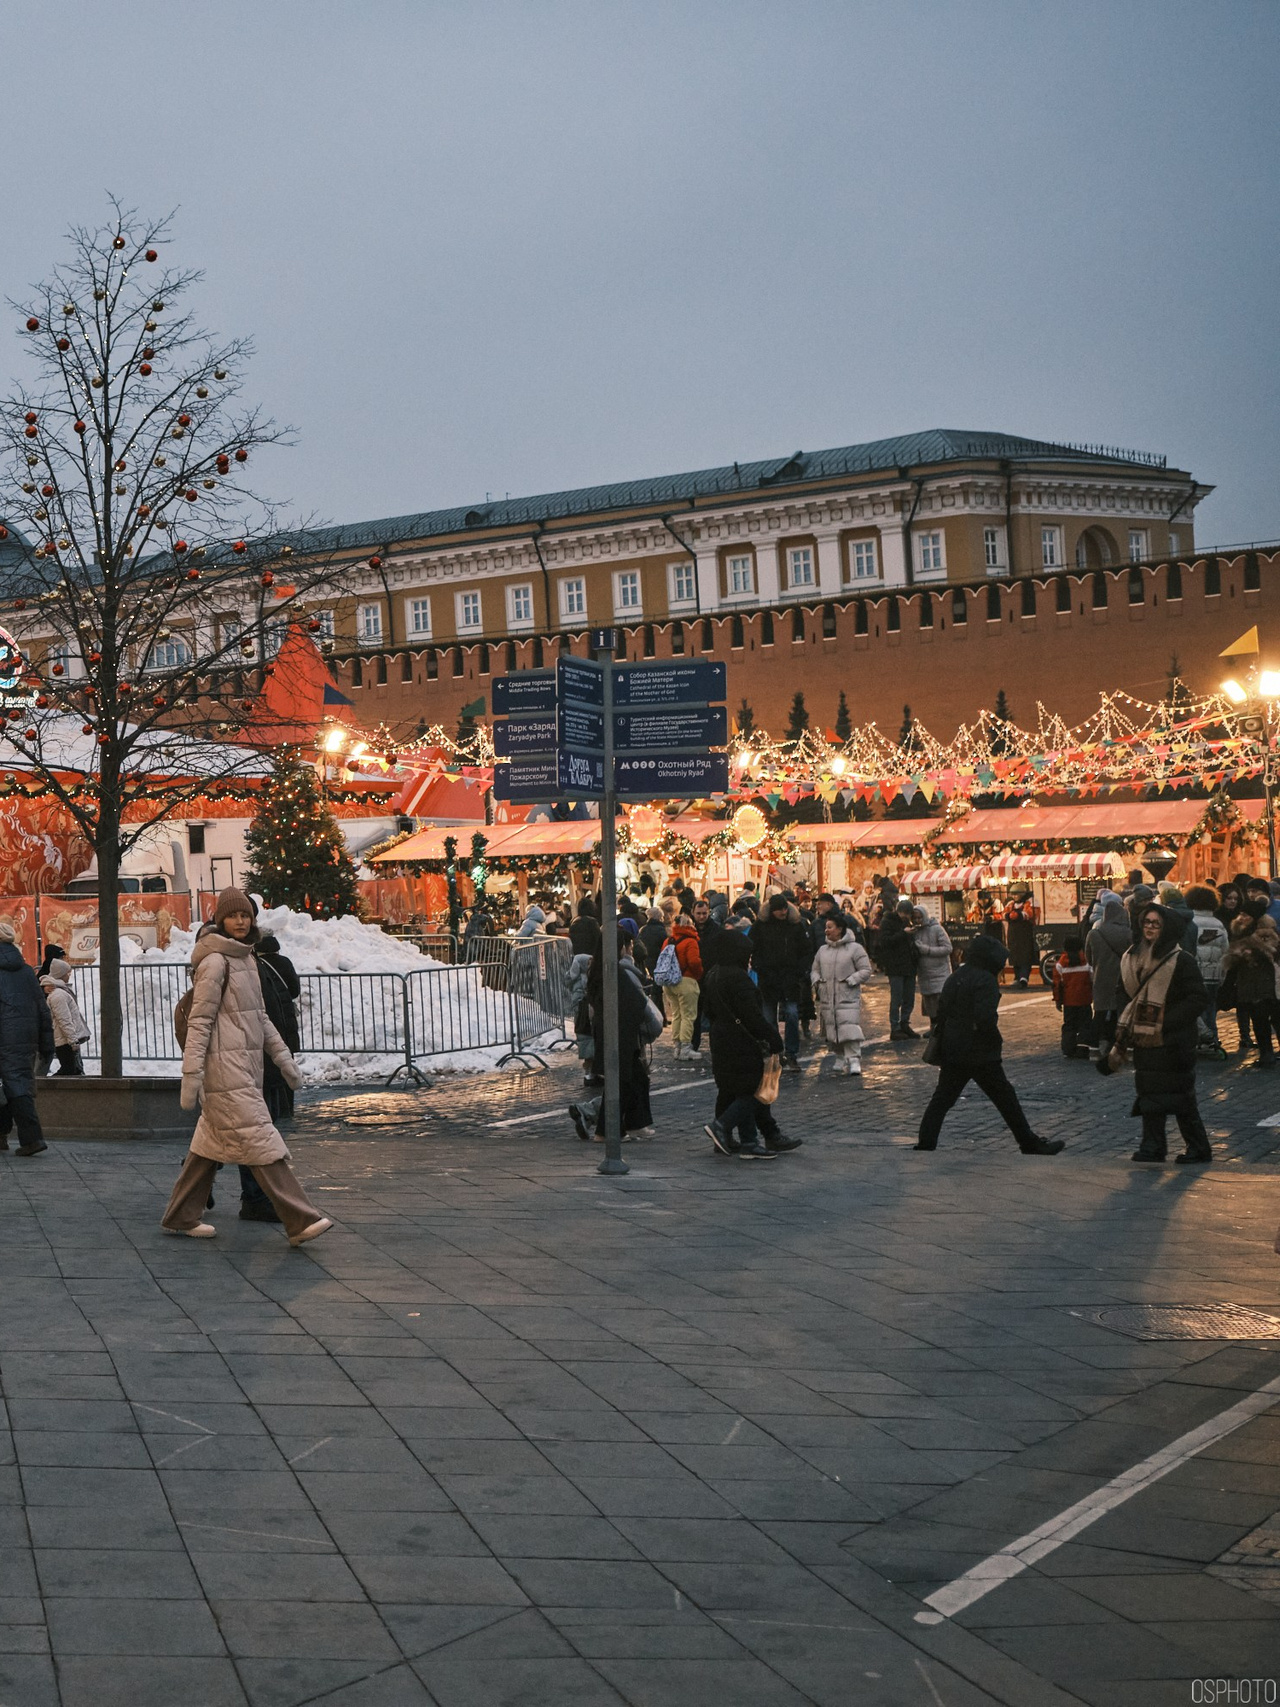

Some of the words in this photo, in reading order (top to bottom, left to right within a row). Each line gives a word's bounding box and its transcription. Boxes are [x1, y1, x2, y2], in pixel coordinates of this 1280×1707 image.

[508, 724, 527, 734] Парк
[508, 733, 536, 742] Zaryadye
[658, 760, 694, 769] Охотный
[696, 759, 711, 768] Ряд
[688, 769, 704, 778] Ryad
